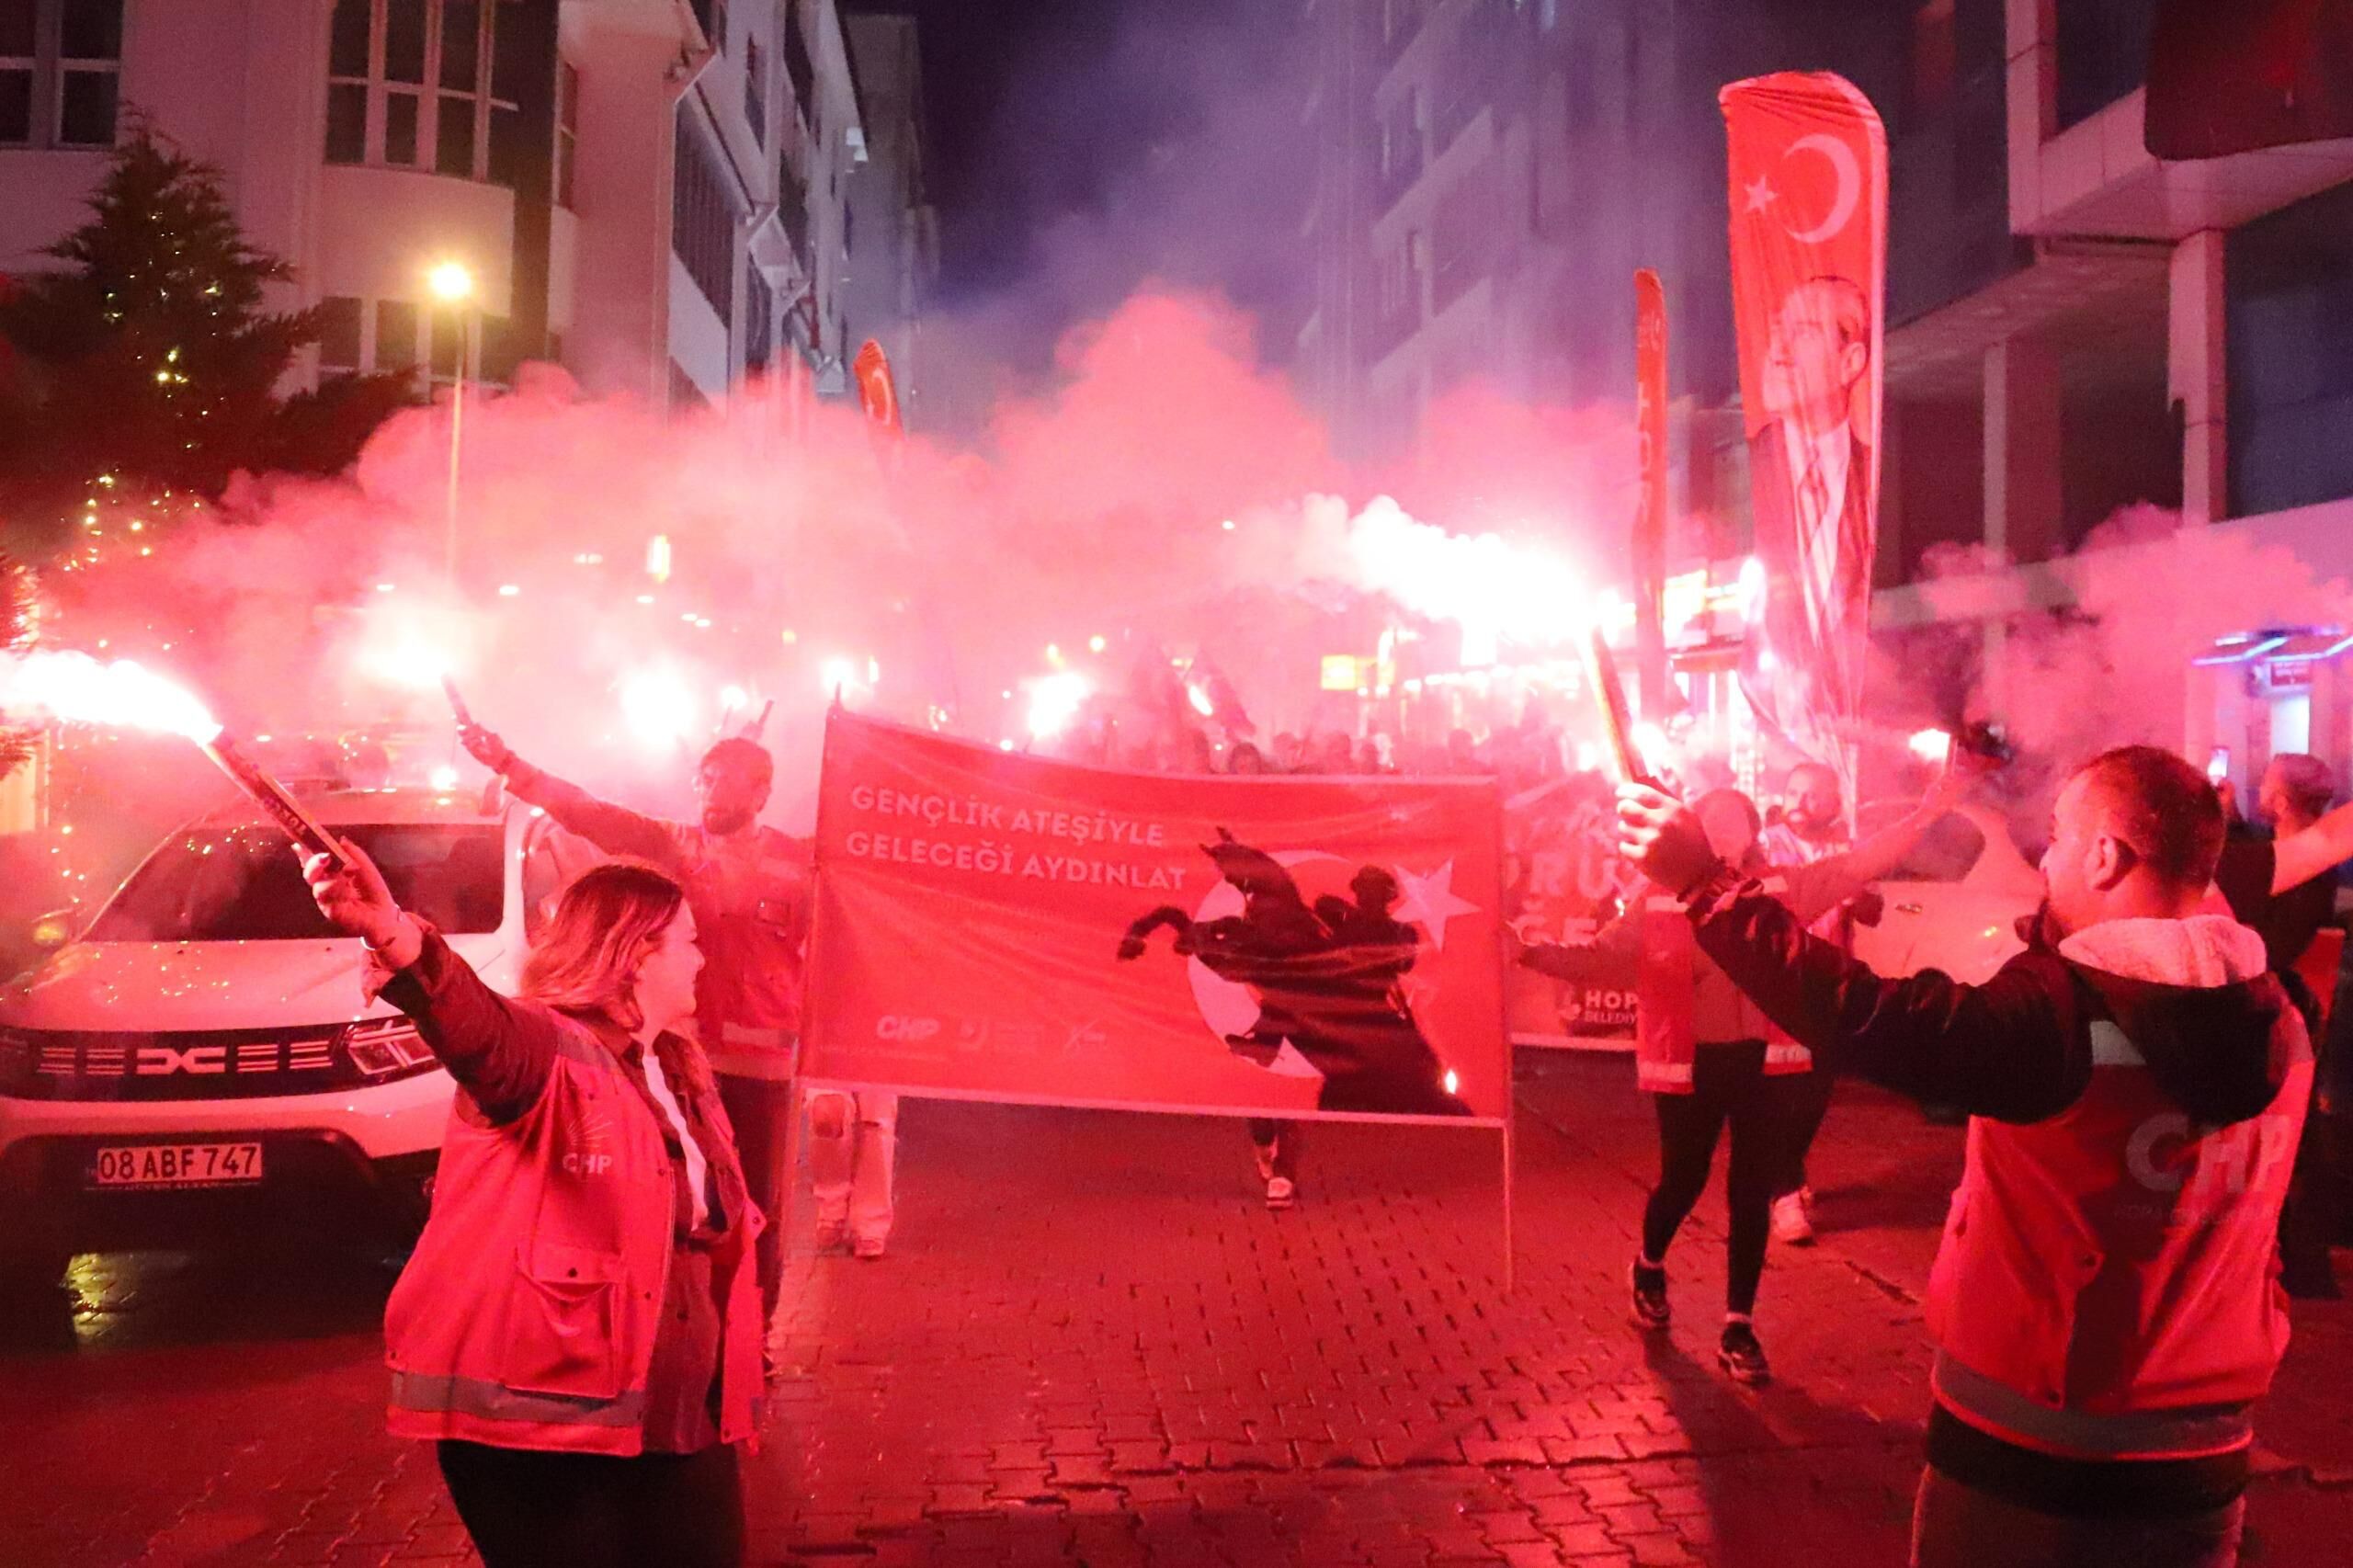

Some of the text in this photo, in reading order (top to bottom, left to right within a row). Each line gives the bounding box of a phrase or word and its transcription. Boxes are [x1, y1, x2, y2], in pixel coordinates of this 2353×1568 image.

[851, 785, 1165, 846] GENÇLİK ATEŞİYLE
[846, 830, 1187, 891] GELECEĞİ AYDINLAT
[1585, 990, 1638, 1009] HOP
[876, 1014, 941, 1042] CHP
[100, 1147, 258, 1180] 08 ABF 747
[562, 1152, 613, 1175] CHP
[2124, 1111, 2291, 1193] CHP
